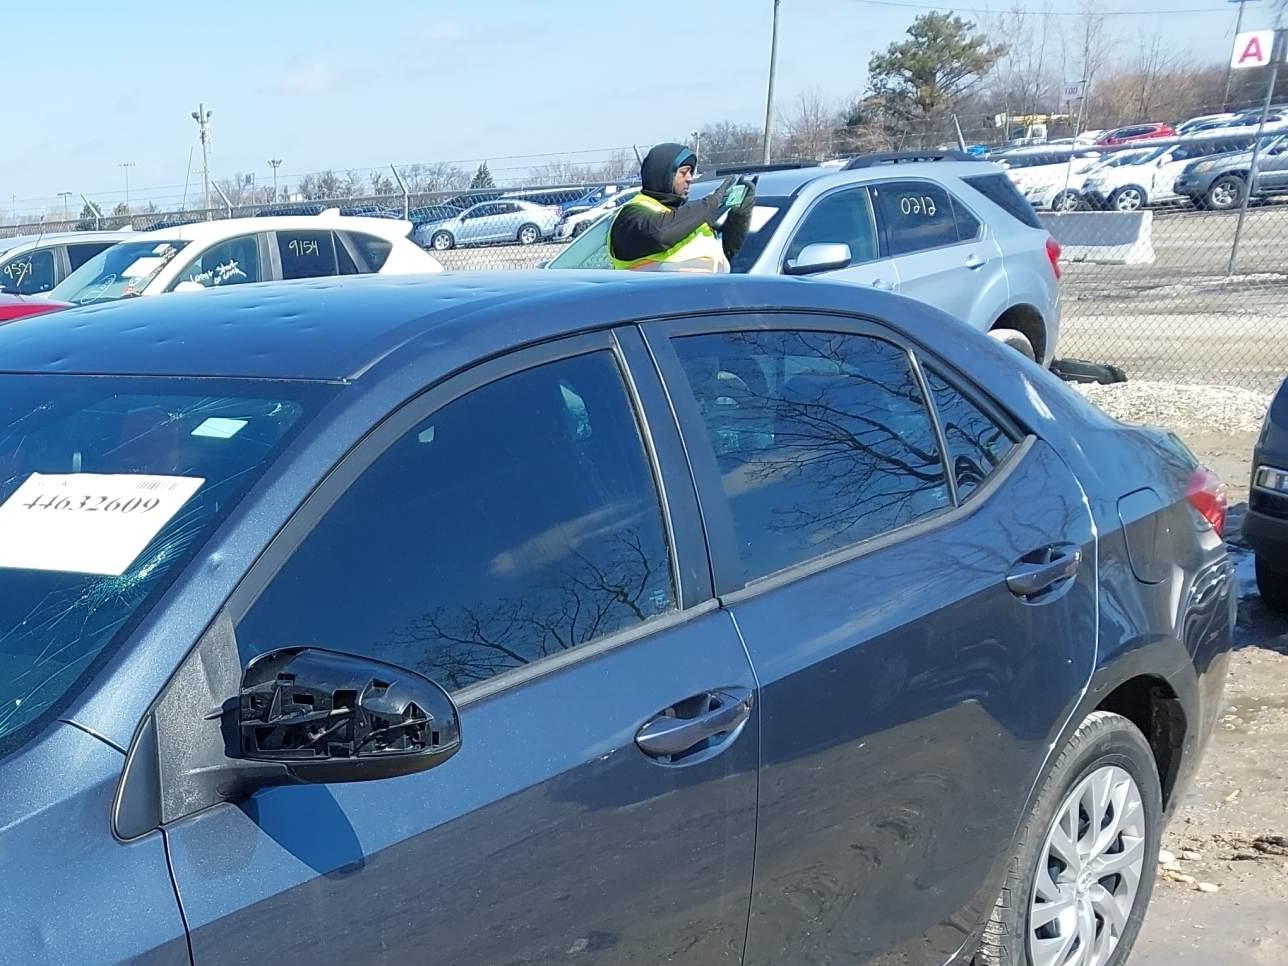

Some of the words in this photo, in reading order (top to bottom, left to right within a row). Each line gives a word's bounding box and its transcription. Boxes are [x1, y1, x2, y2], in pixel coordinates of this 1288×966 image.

[1238, 36, 1263, 63] A
[900, 196, 936, 216] 0212
[288, 239, 320, 257] 9154
[23, 494, 161, 513] 44632609
